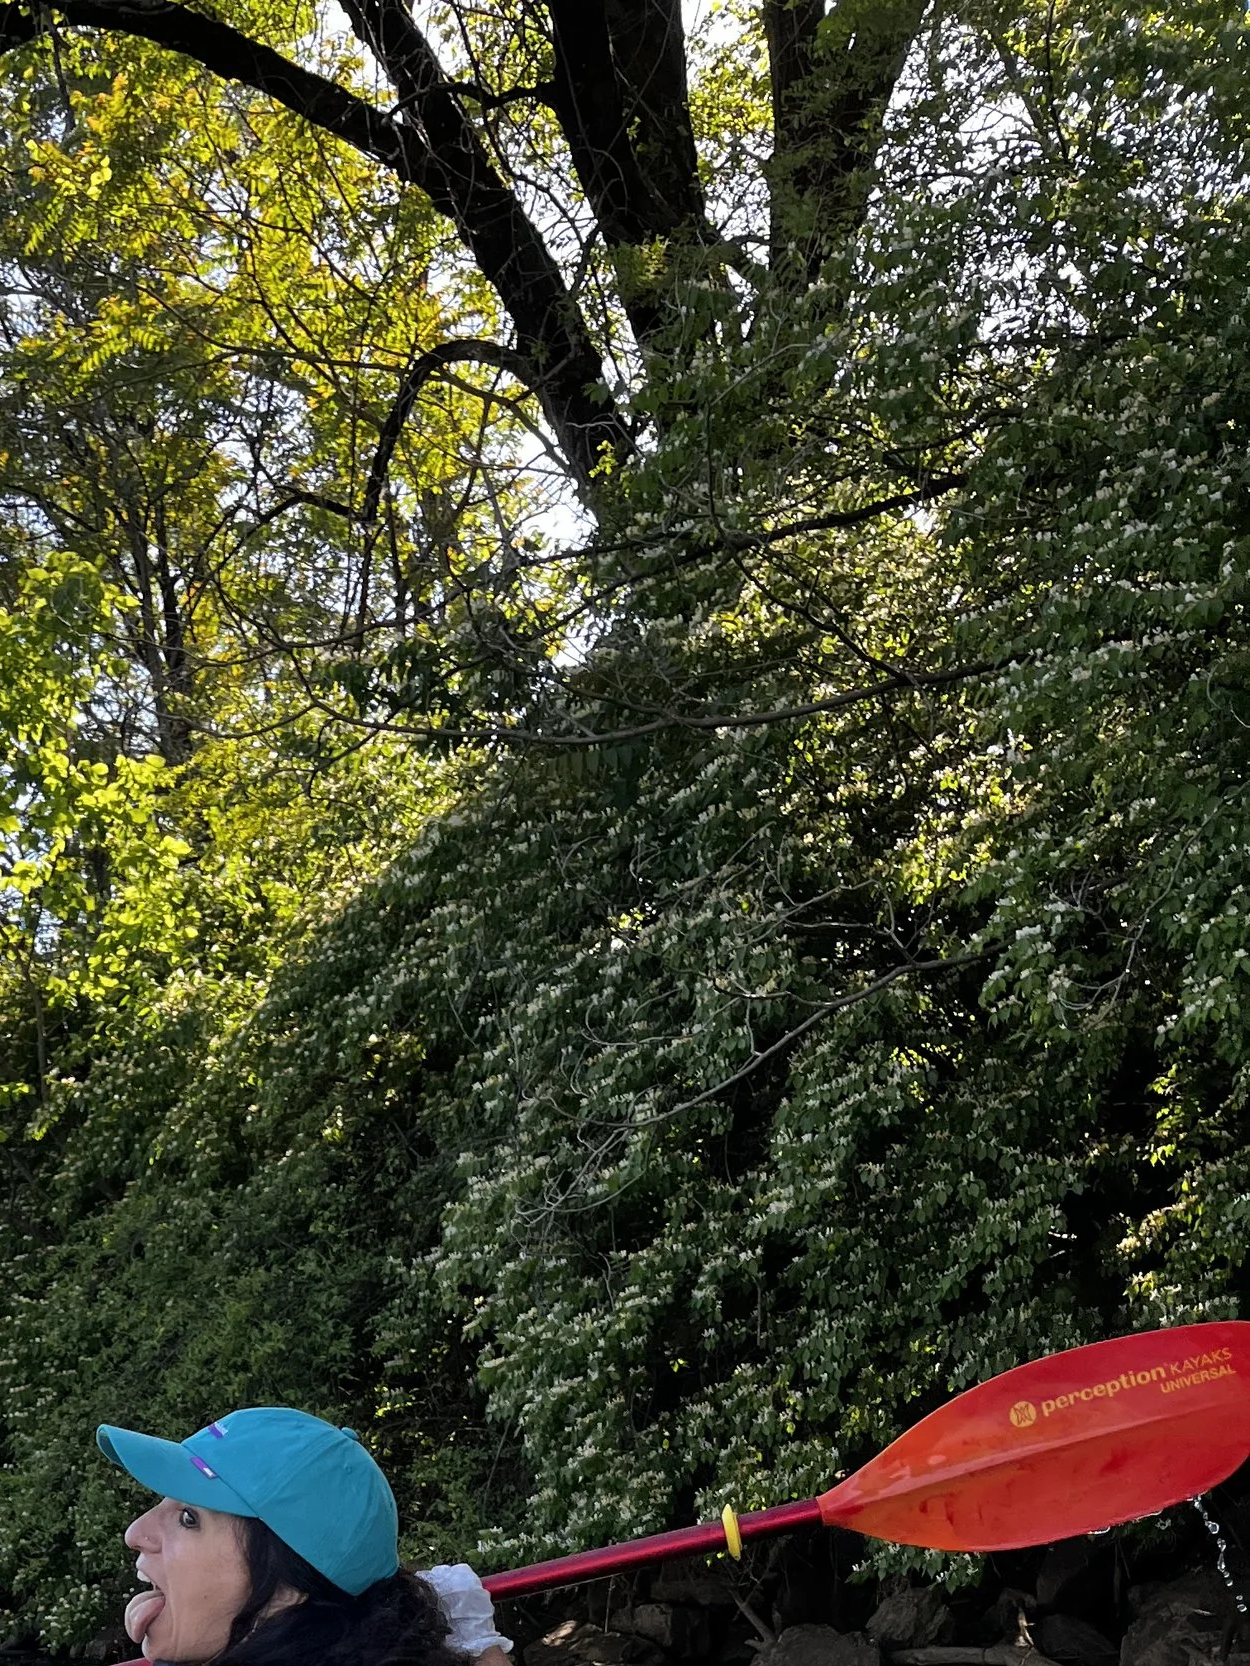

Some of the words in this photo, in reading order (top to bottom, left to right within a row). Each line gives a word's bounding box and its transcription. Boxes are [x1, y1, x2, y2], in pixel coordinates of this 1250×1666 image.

[1042, 1364, 1167, 1417] perception
[1170, 1347, 1233, 1376] KAYAKS
[1160, 1364, 1237, 1394] UNIVERSAL
